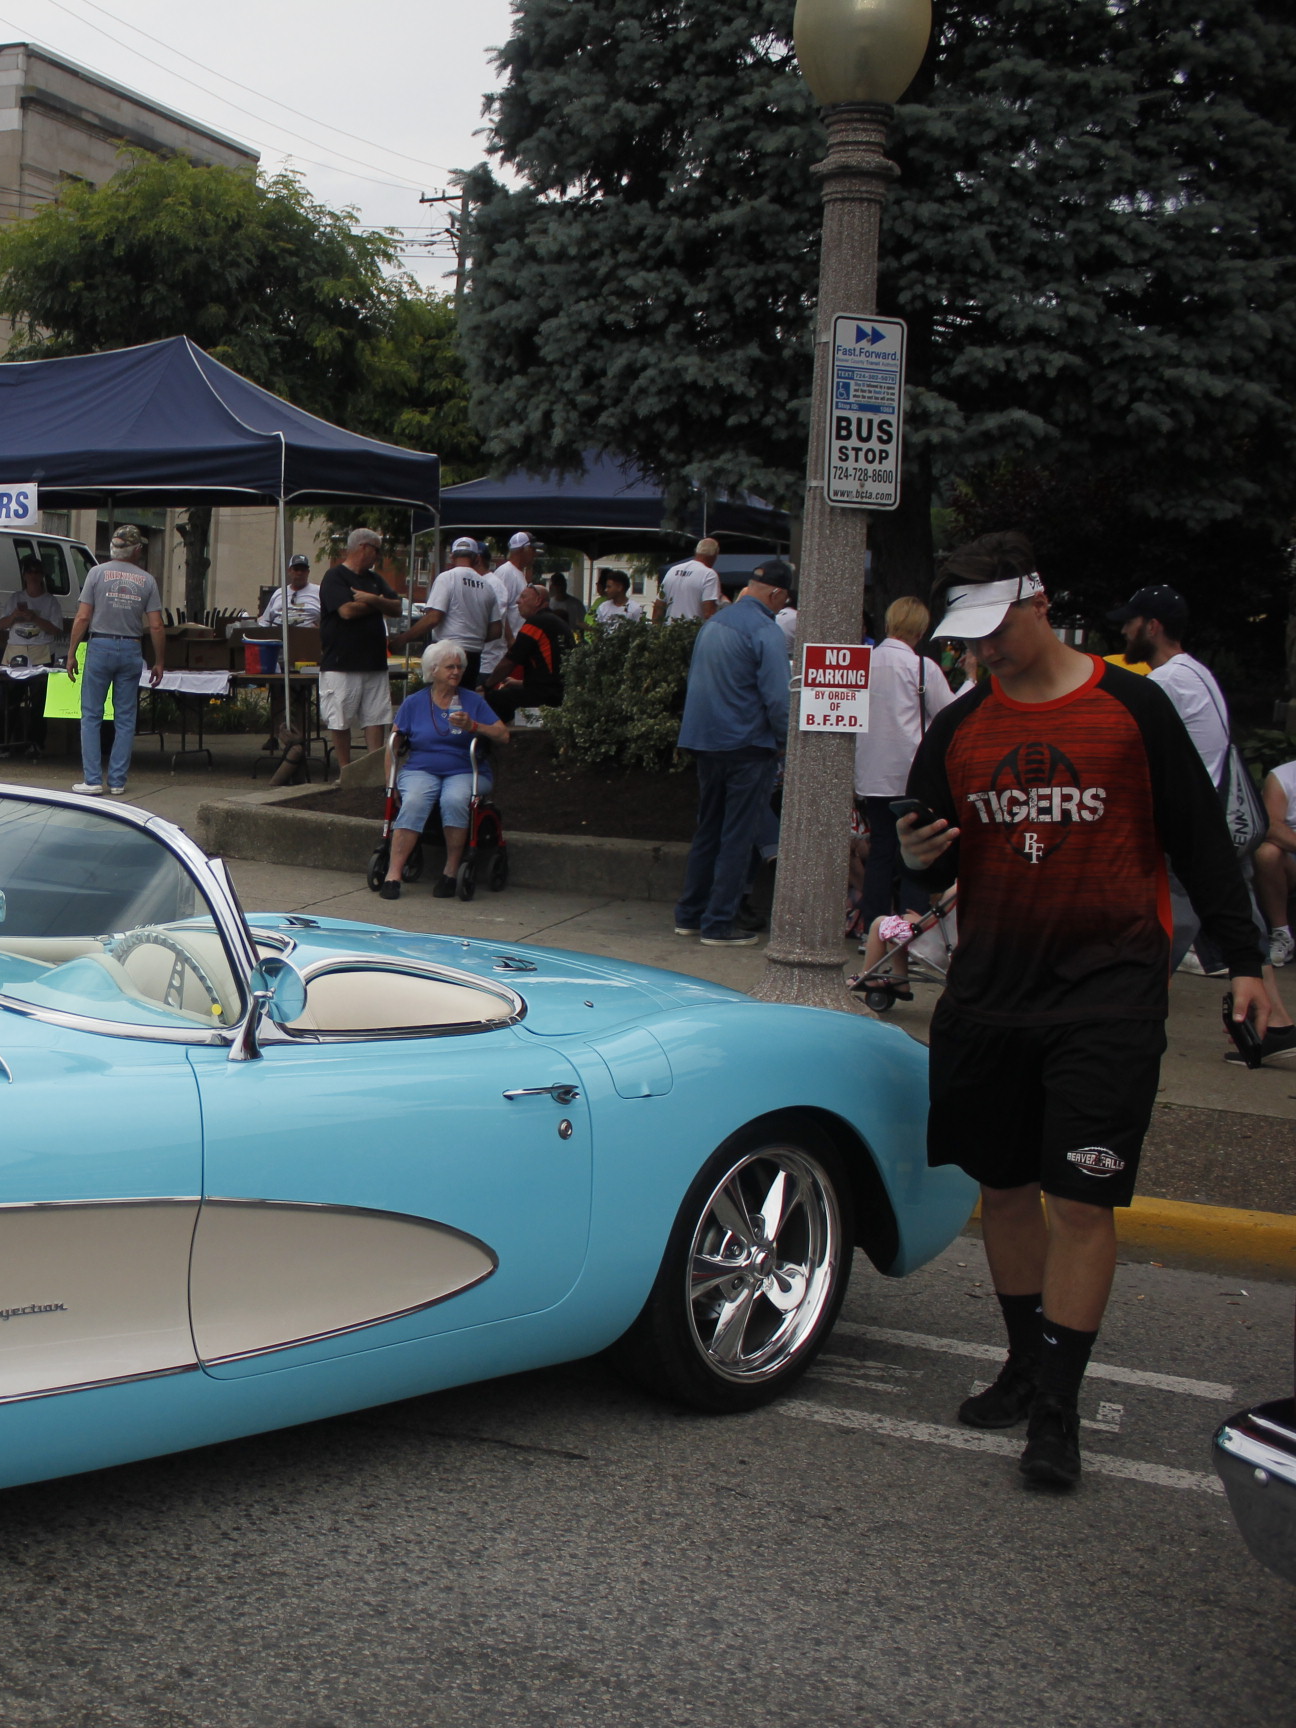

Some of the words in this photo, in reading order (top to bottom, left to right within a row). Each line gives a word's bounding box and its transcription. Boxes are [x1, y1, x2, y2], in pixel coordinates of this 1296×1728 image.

[835, 416, 893, 445] BUS
[838, 446, 889, 465] STOP
[833, 466, 893, 484] 724-728-8600
[463, 577, 484, 590] STAFF
[825, 649, 851, 666] NO
[807, 669, 865, 685] PARKING
[815, 691, 825, 700] BY
[828, 691, 856, 701] ORDER
[830, 702, 841, 711] OF
[806, 714, 863, 727] B.F.P.D.
[966, 786, 1106, 823] TIGERS
[1233, 807, 1250, 847] ENN
[1067, 1152, 1096, 1165] BEAVER
[1100, 1155, 1125, 1170] FALLS
